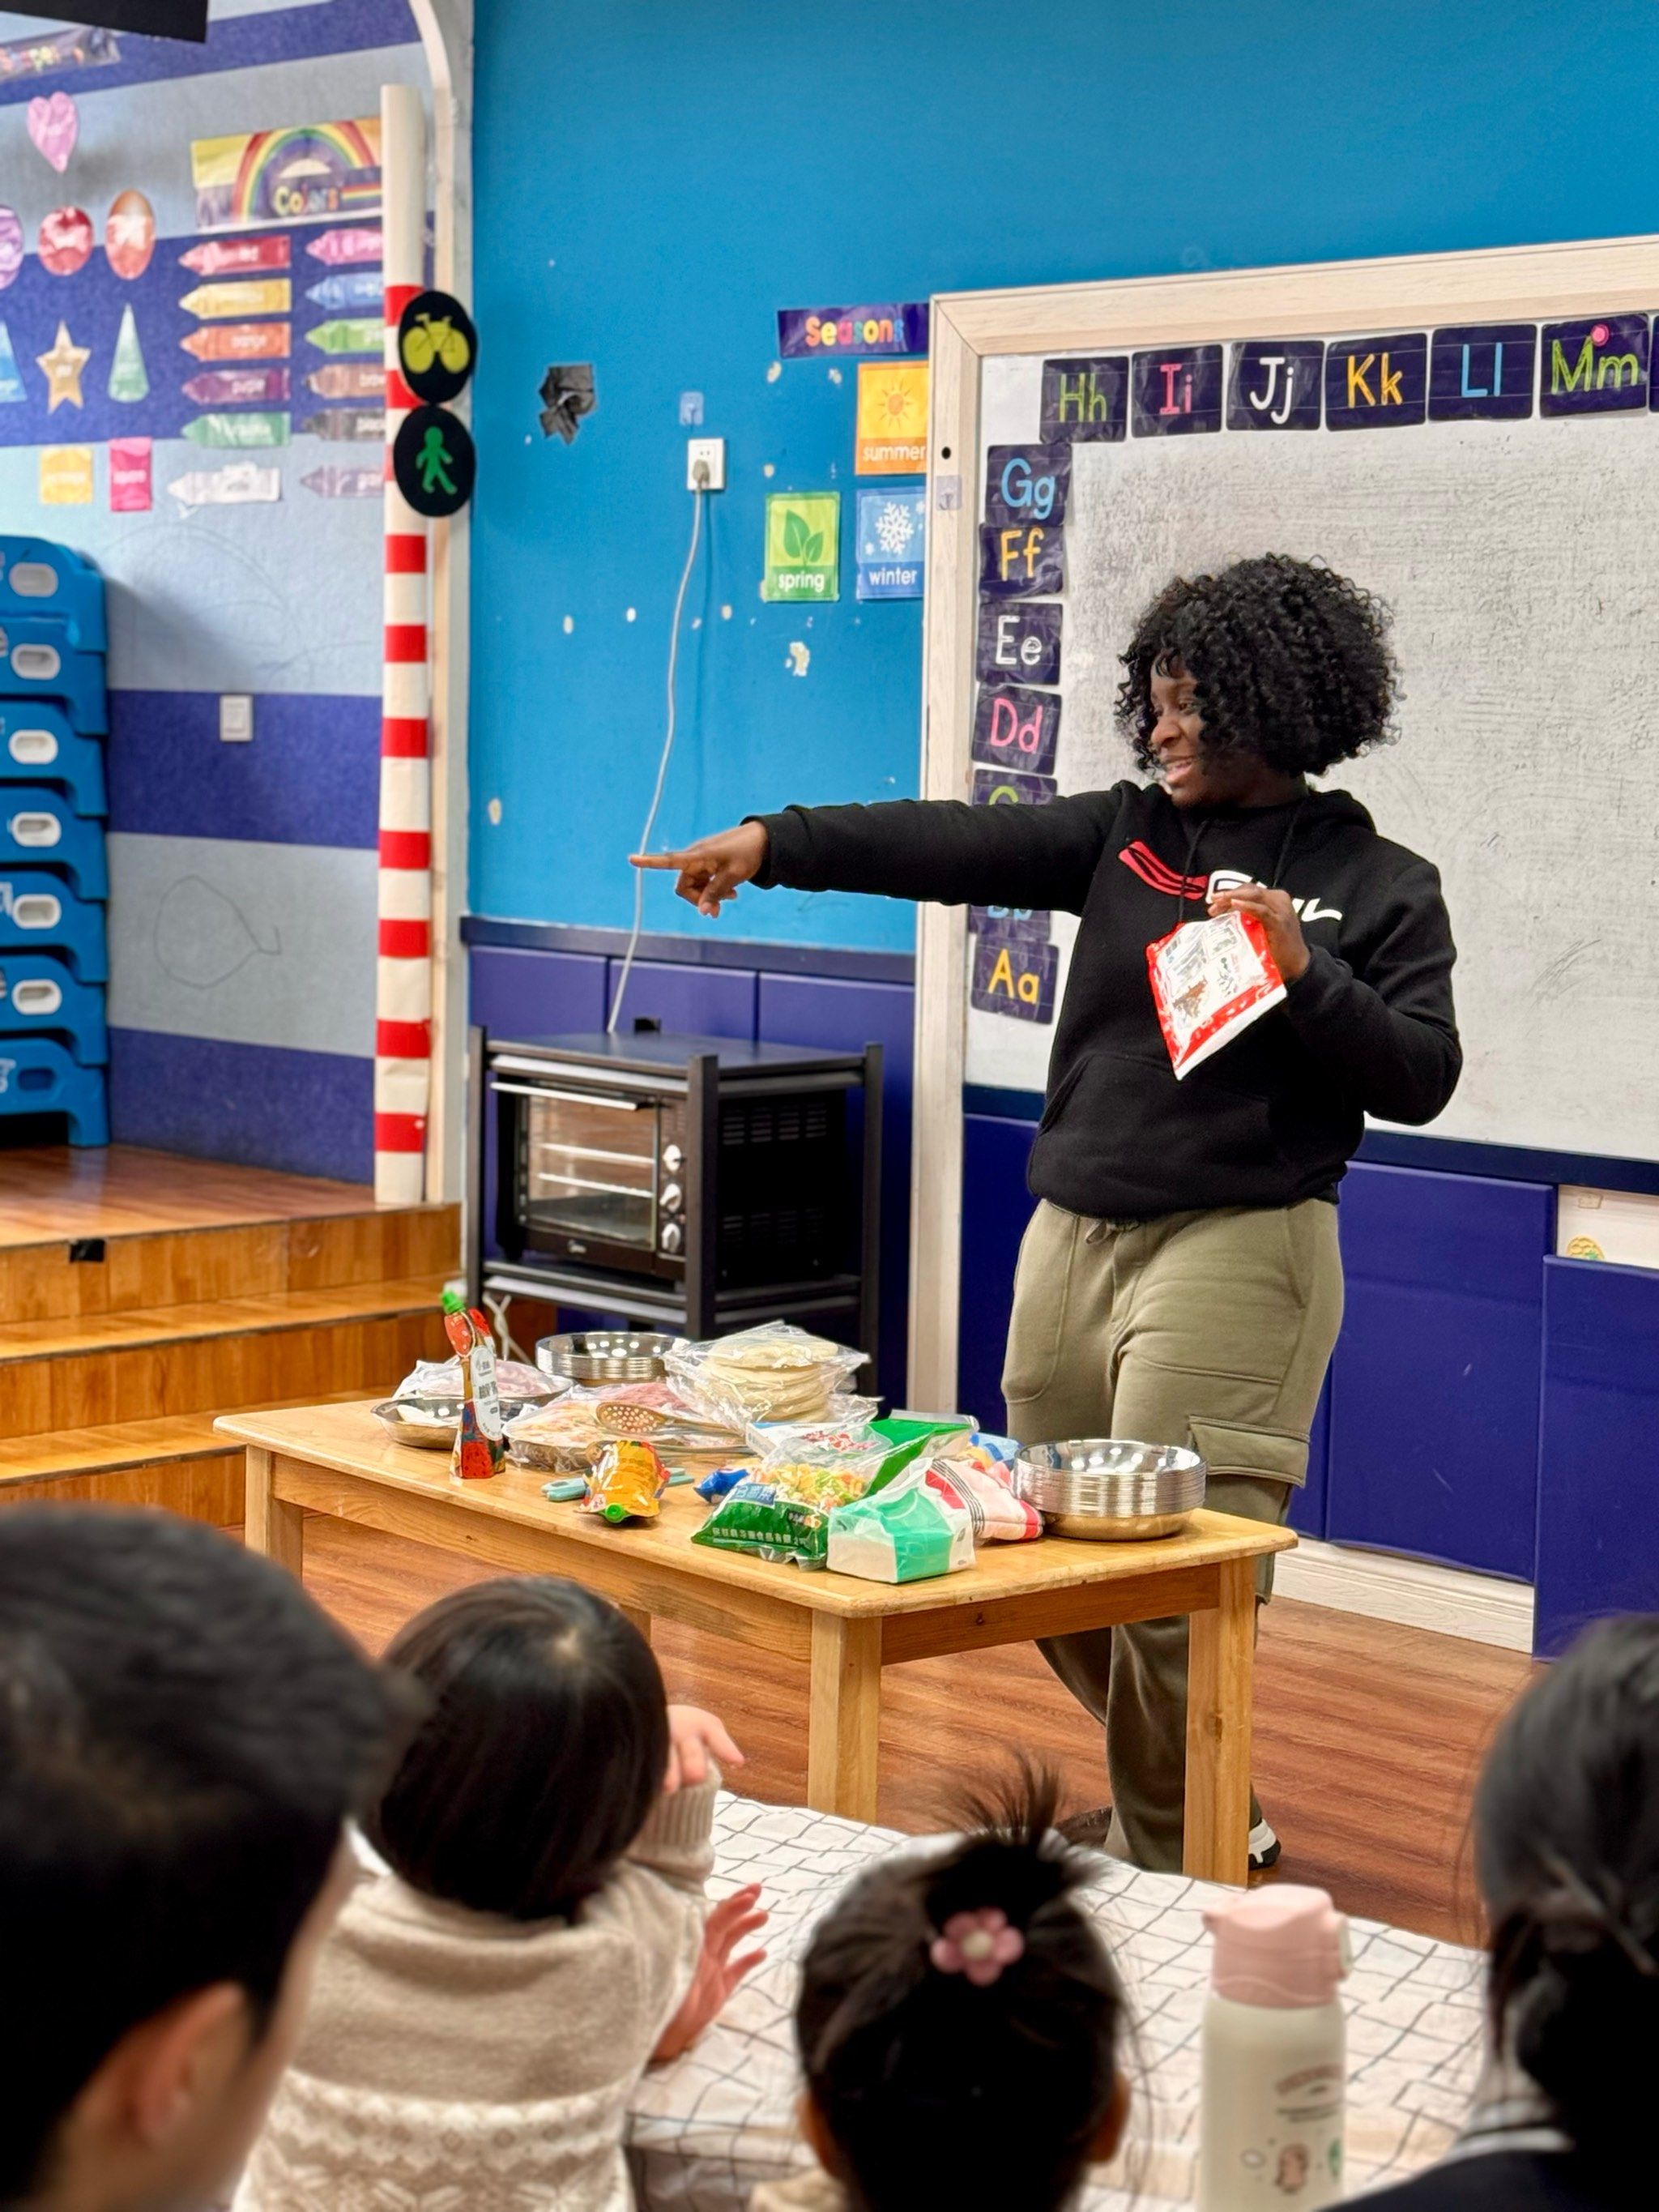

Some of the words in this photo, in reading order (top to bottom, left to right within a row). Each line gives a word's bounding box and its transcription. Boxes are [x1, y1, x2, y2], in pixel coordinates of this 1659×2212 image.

[805, 316, 904, 347] Seasons
[1159, 363, 1192, 416] Ii
[1249, 357, 1294, 425] Jj
[1348, 352, 1403, 408] Kk
[1461, 342, 1503, 397] Ll
[1551, 335, 1639, 395] Mm
[1059, 373, 1107, 423] Hh
[863, 445, 925, 461] summer
[1001, 458, 1056, 519] Gg
[778, 571, 825, 593] spring
[869, 568, 917, 586] winter
[1000, 527, 1044, 582] Ff
[996, 615, 1043, 665] Ee
[990, 698, 1043, 754] Dd
[987, 948, 1040, 1005] Aa
